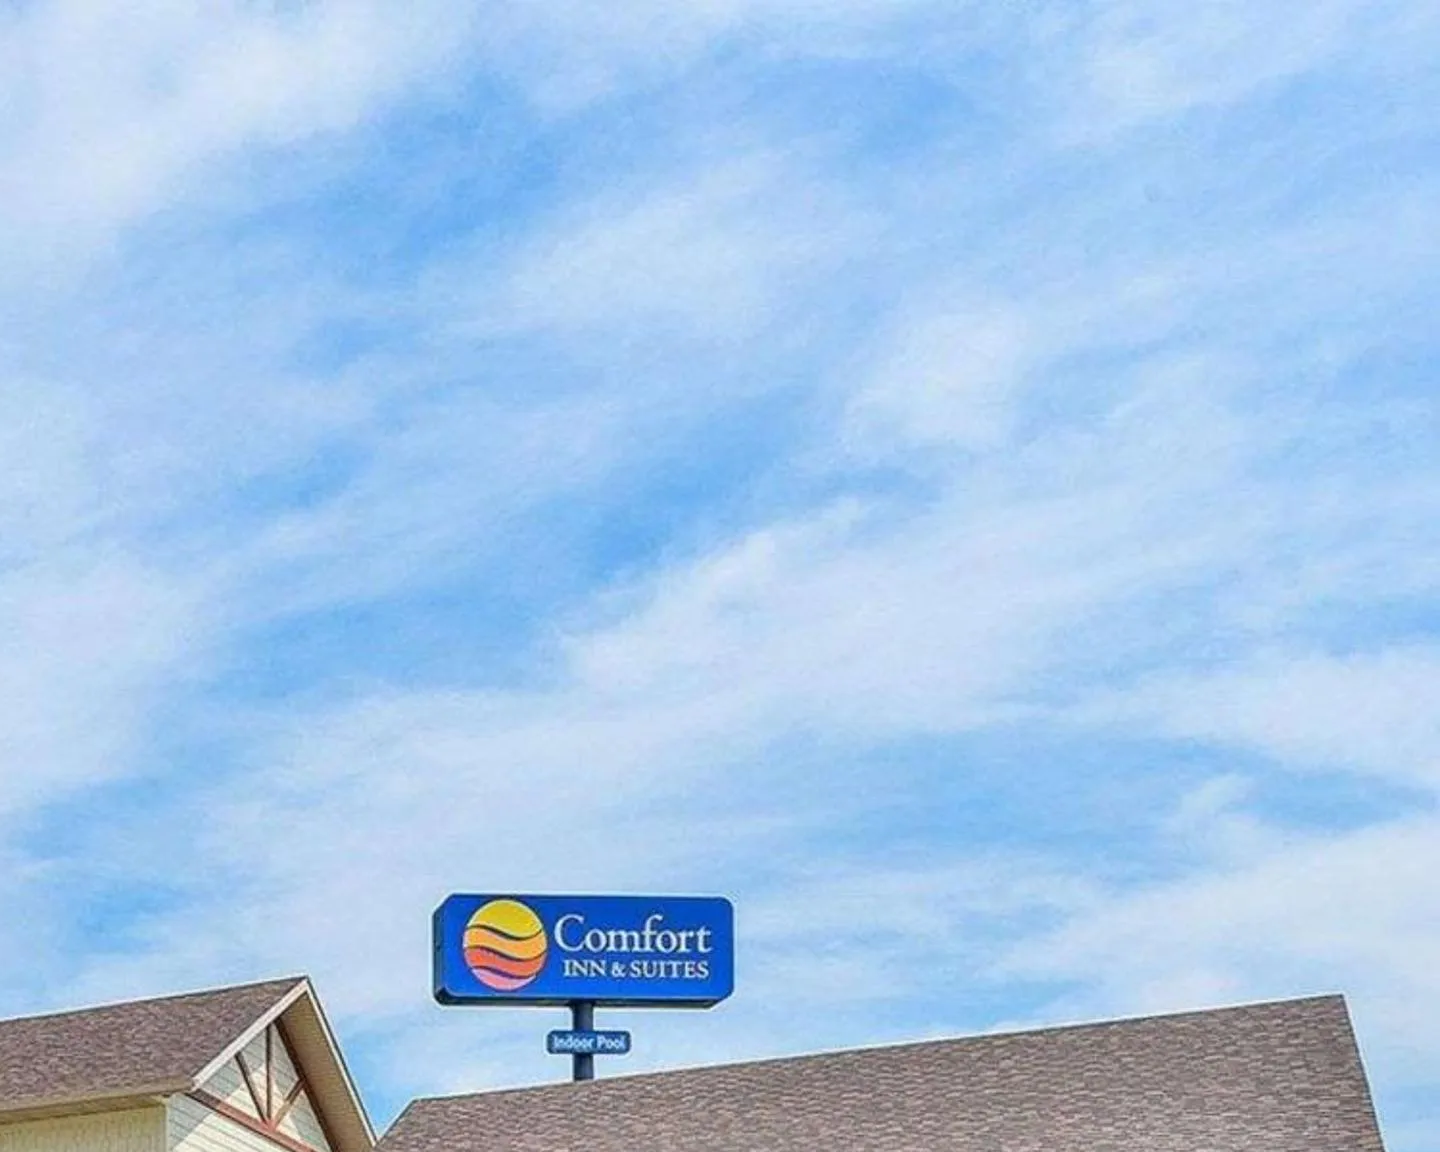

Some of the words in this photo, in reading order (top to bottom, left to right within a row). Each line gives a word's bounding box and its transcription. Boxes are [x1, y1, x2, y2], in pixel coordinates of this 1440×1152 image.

[553, 913, 713, 953] Comfort
[563, 959, 606, 978] INN
[611, 961, 626, 978] &
[629, 960, 710, 979] SUITES
[551, 1033, 594, 1050] Indoor
[596, 1034, 626, 1050] Pool
